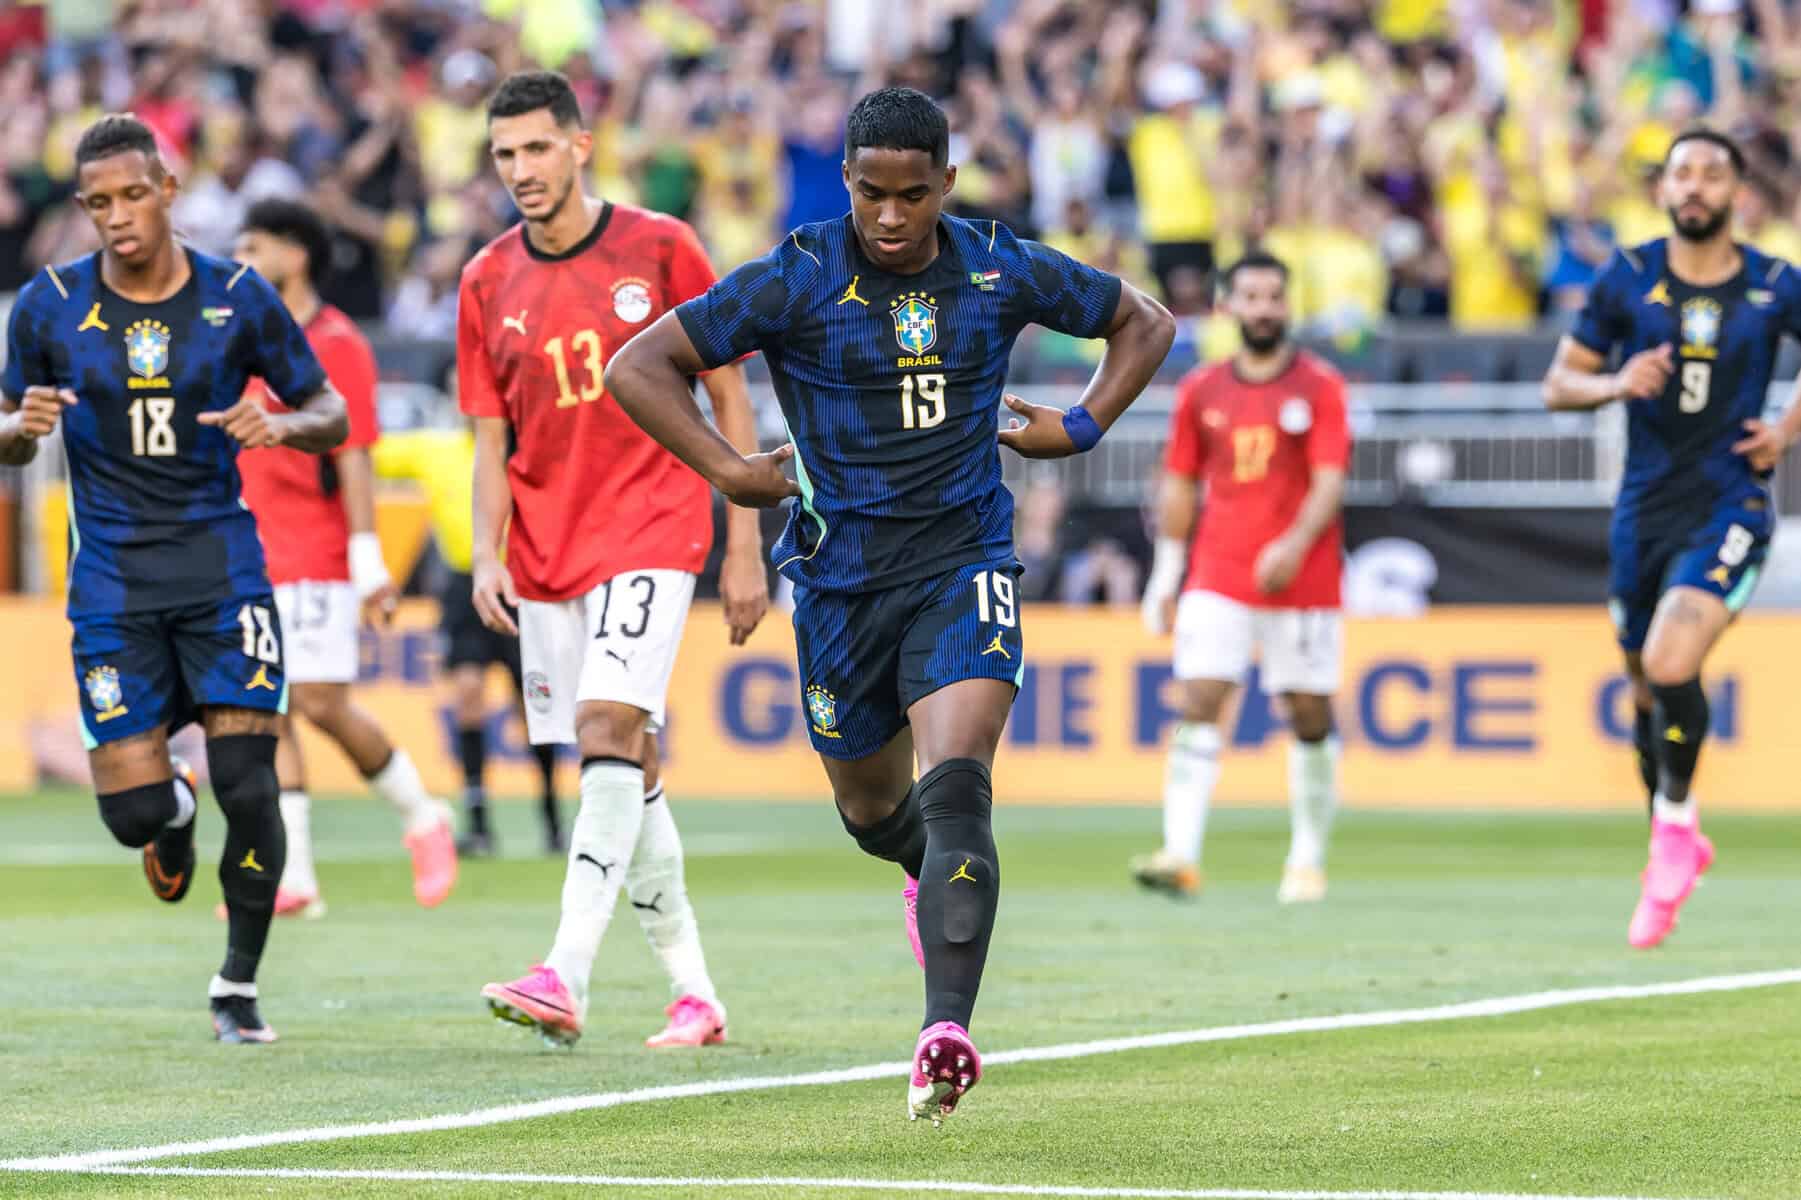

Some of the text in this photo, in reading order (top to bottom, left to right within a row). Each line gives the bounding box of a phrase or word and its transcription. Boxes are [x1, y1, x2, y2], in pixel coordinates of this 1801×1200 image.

[906, 320, 923, 329] CBF
[543, 329, 604, 408] 13
[897, 355, 942, 368] BRASIL
[1679, 361, 1711, 413] 9
[127, 397, 177, 456] 18
[898, 373, 947, 429] 19
[594, 575, 656, 639] 13
[972, 570, 1016, 628] 19
[237, 603, 280, 665] 18
[720, 659, 1095, 748] GE
